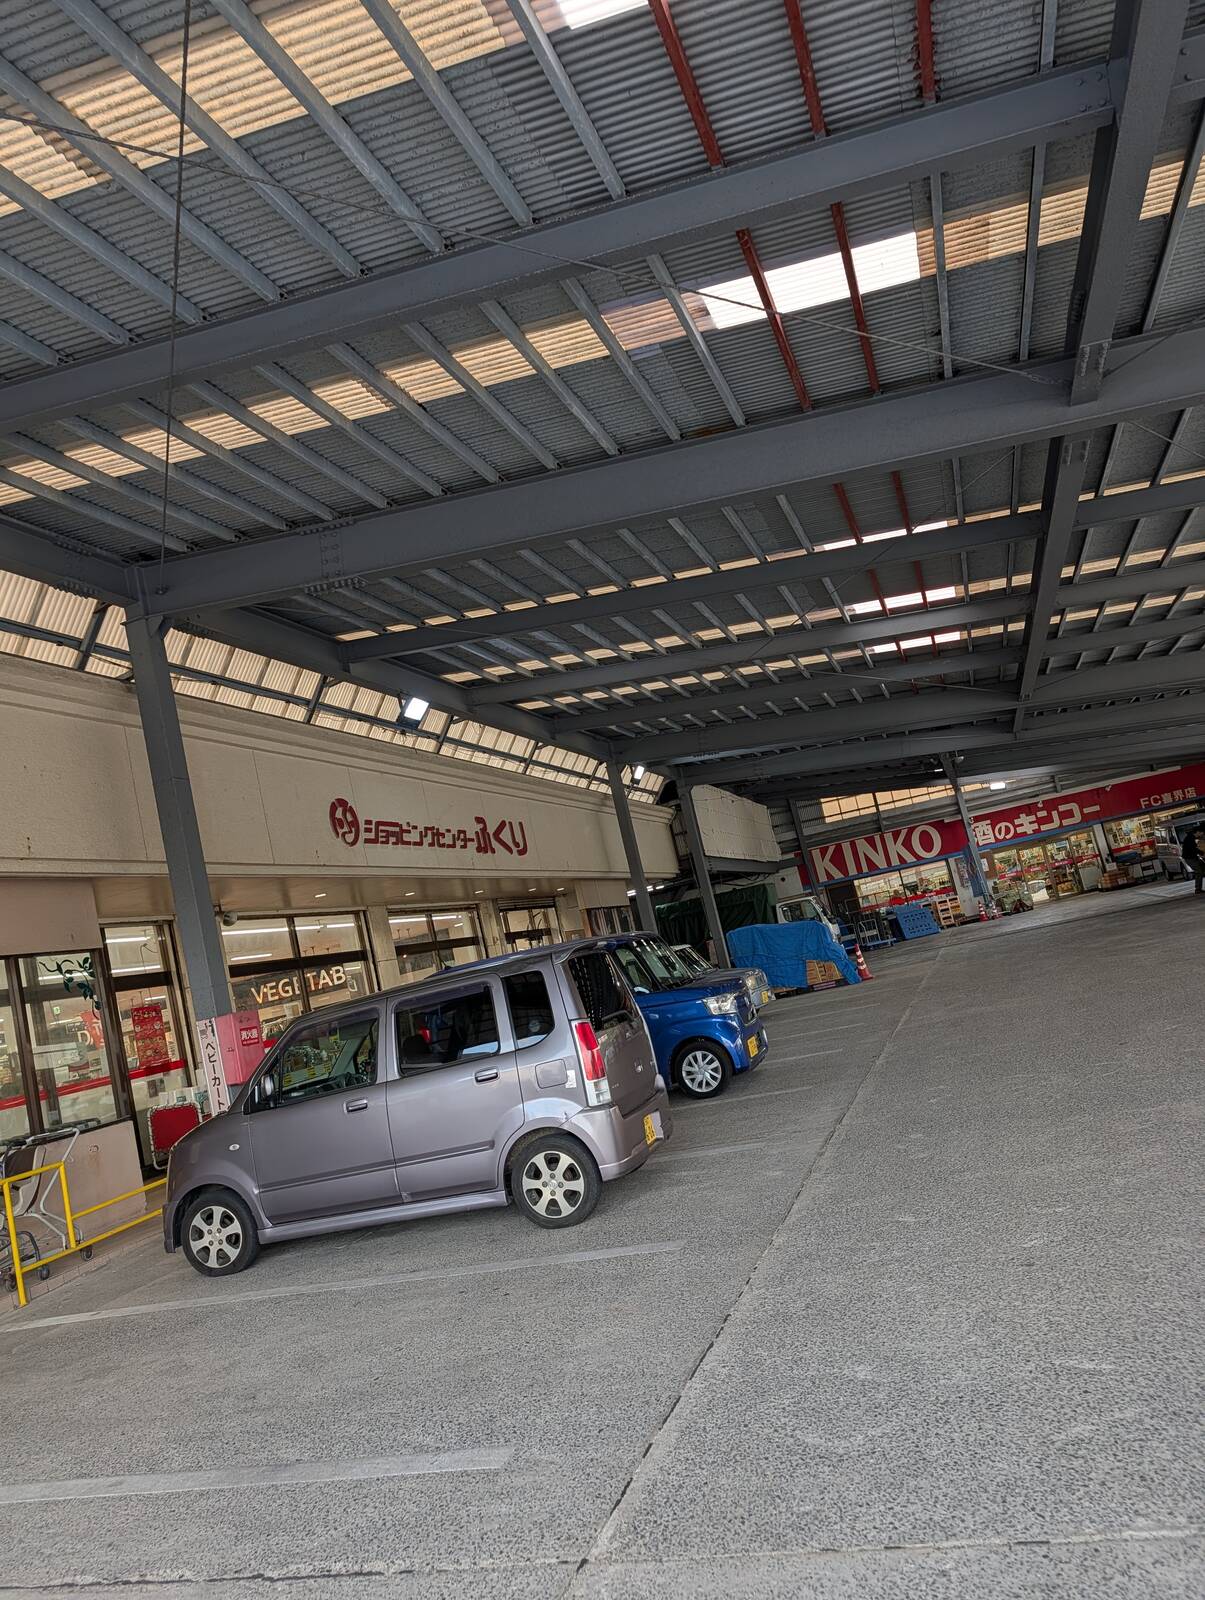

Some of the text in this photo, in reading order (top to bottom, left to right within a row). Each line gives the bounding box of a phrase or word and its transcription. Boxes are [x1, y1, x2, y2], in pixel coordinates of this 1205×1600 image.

[973, 802, 1100, 846] 酒のキンコー
[811, 824, 942, 883] KINKO
